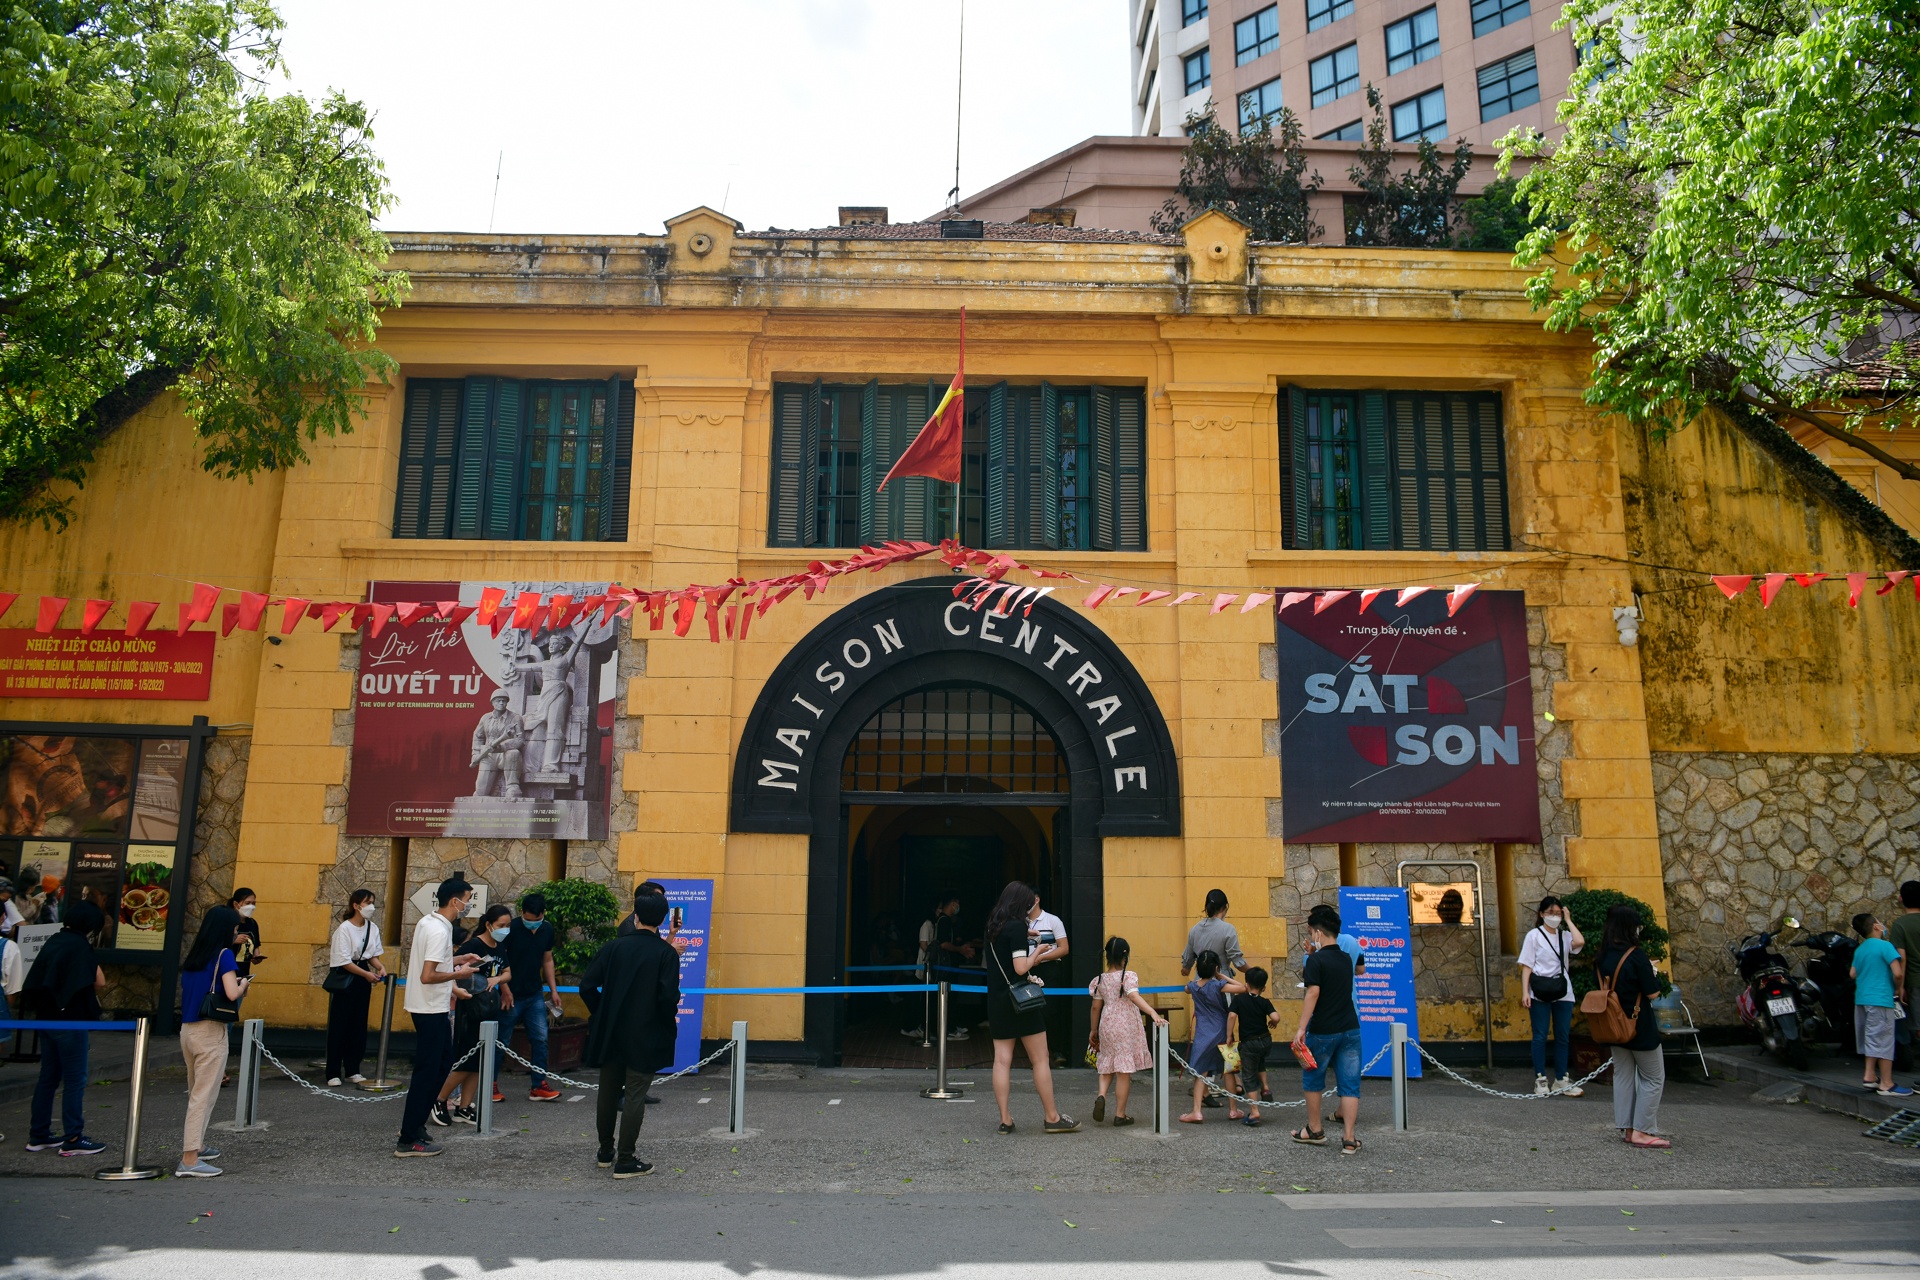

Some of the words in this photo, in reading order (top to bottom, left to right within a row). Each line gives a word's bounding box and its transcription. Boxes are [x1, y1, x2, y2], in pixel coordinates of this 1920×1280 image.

[25, 636, 60, 654] NHIỆT
[62, 636, 87, 655] LIỆT
[89, 637, 121, 653] CHÀO
[123, 637, 156, 653] MỪNG
[368, 632, 419, 667] Lời
[424, 627, 462, 659] thề
[1347, 625, 1378, 636] Trưng
[1381, 625, 1400, 636] bày
[1403, 626, 1441, 636] chuyên
[1444, 626, 1458, 635] đề
[361, 669, 441, 695] QUYẾT
[449, 666, 484, 695] TỬ
[757, 618, 905, 792] MAISON
[943, 600, 1147, 793] CENTRALE
[1304, 655, 1418, 714] SẮT
[1395, 724, 1520, 765] SON
